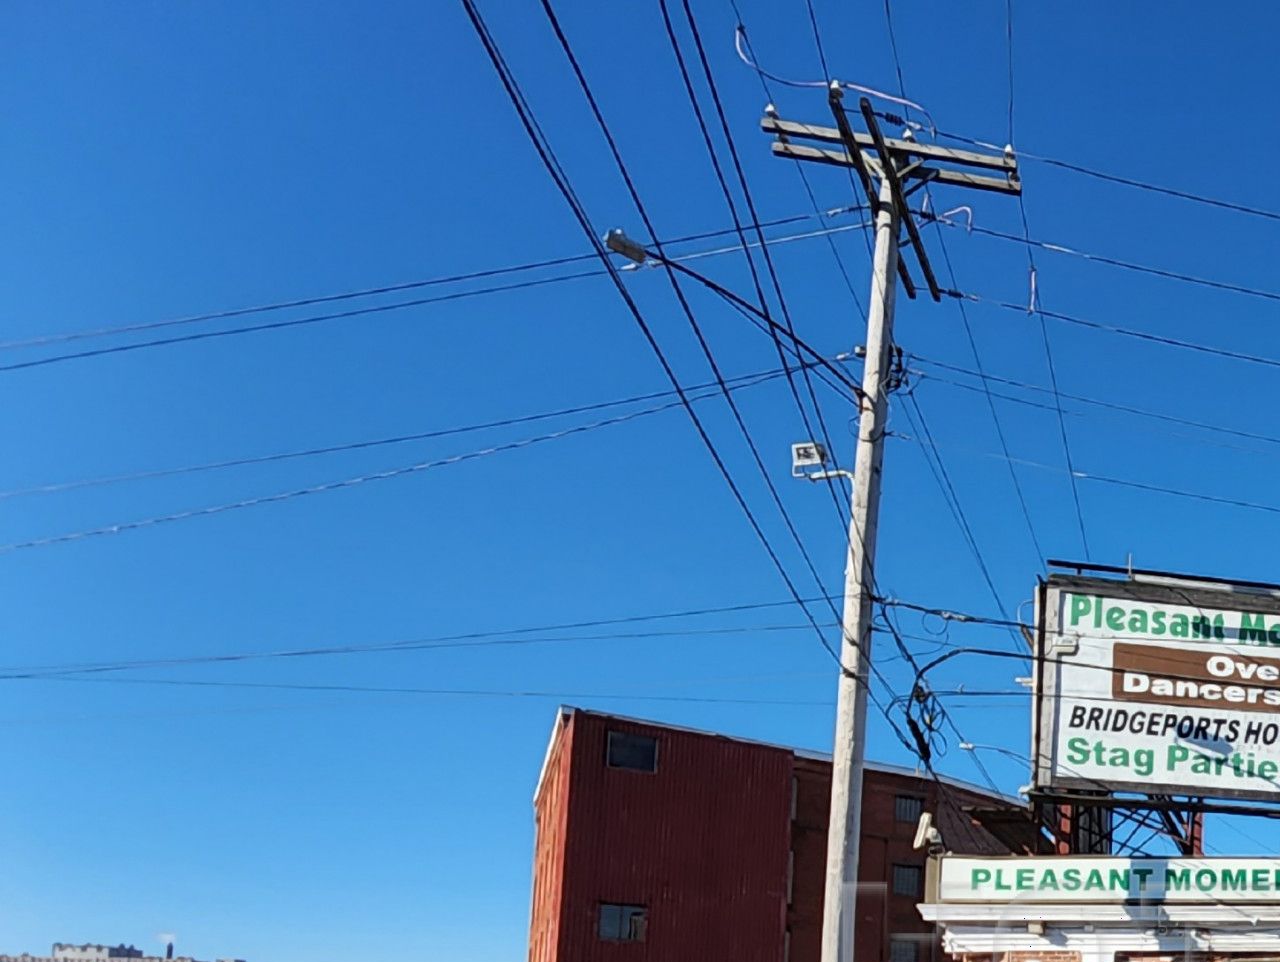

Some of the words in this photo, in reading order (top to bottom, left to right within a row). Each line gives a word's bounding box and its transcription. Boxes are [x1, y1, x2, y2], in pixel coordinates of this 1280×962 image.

[1069, 594, 1226, 640] Pleasant
[1068, 705, 1240, 743] BRIDGEPORTS
[1066, 737, 1154, 776] Stag
[971, 867, 1152, 892] PLEASANT
